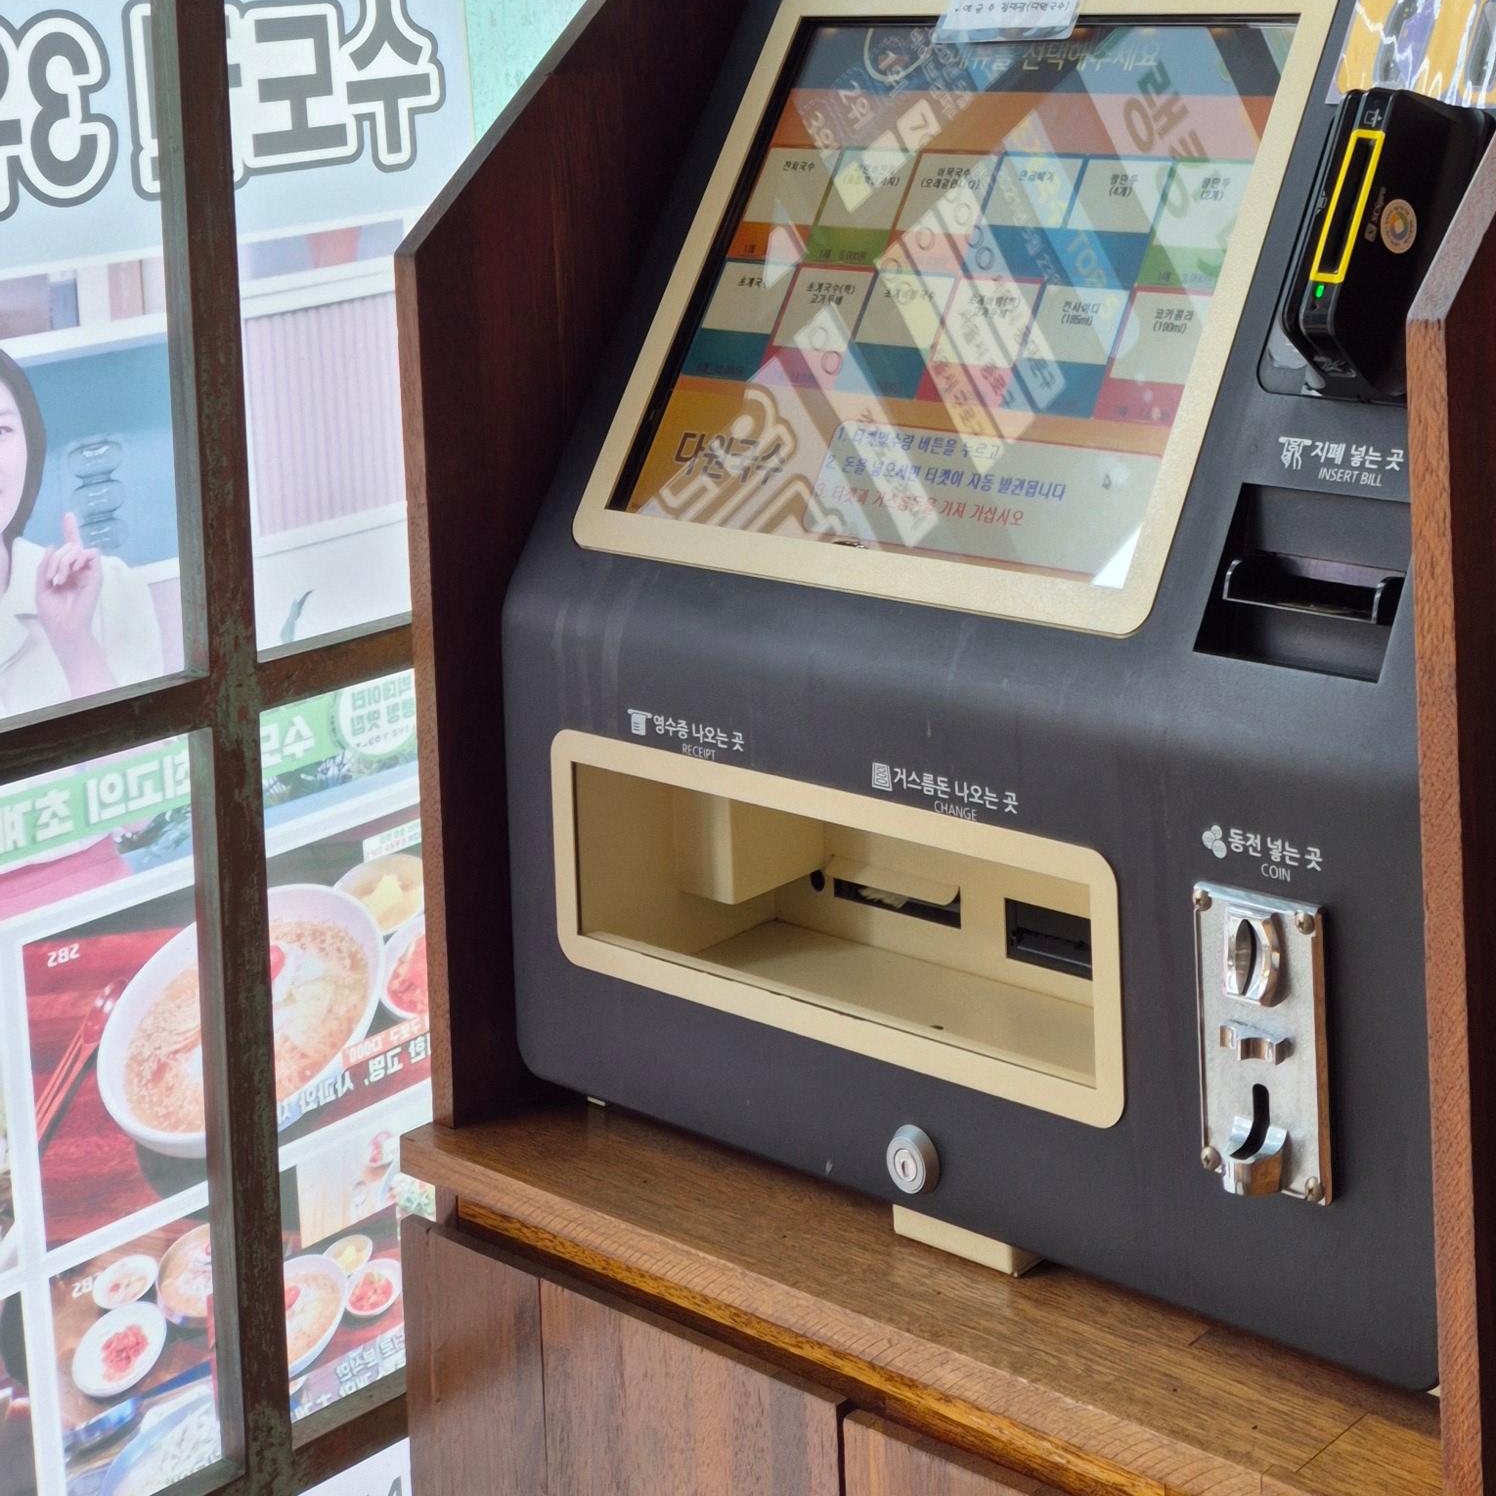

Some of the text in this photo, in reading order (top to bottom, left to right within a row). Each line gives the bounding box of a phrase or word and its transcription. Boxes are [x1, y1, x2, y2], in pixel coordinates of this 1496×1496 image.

[674, 431, 785, 486] 다원국수
[1311, 440, 1405, 472] 지폐 넣는 곳
[1318, 467, 1383, 488] INSERT BILL
[652, 714, 745, 753] 영수증 나오는 곳
[681, 742, 716, 761] RECEIPT
[892, 766, 1019, 815] 거스름돈 나오는 곳
[933, 800, 978, 822] CHANGE
[1227, 827, 1323, 872] 동전 넣는 곳
[1260, 863, 1291, 882] COIN
